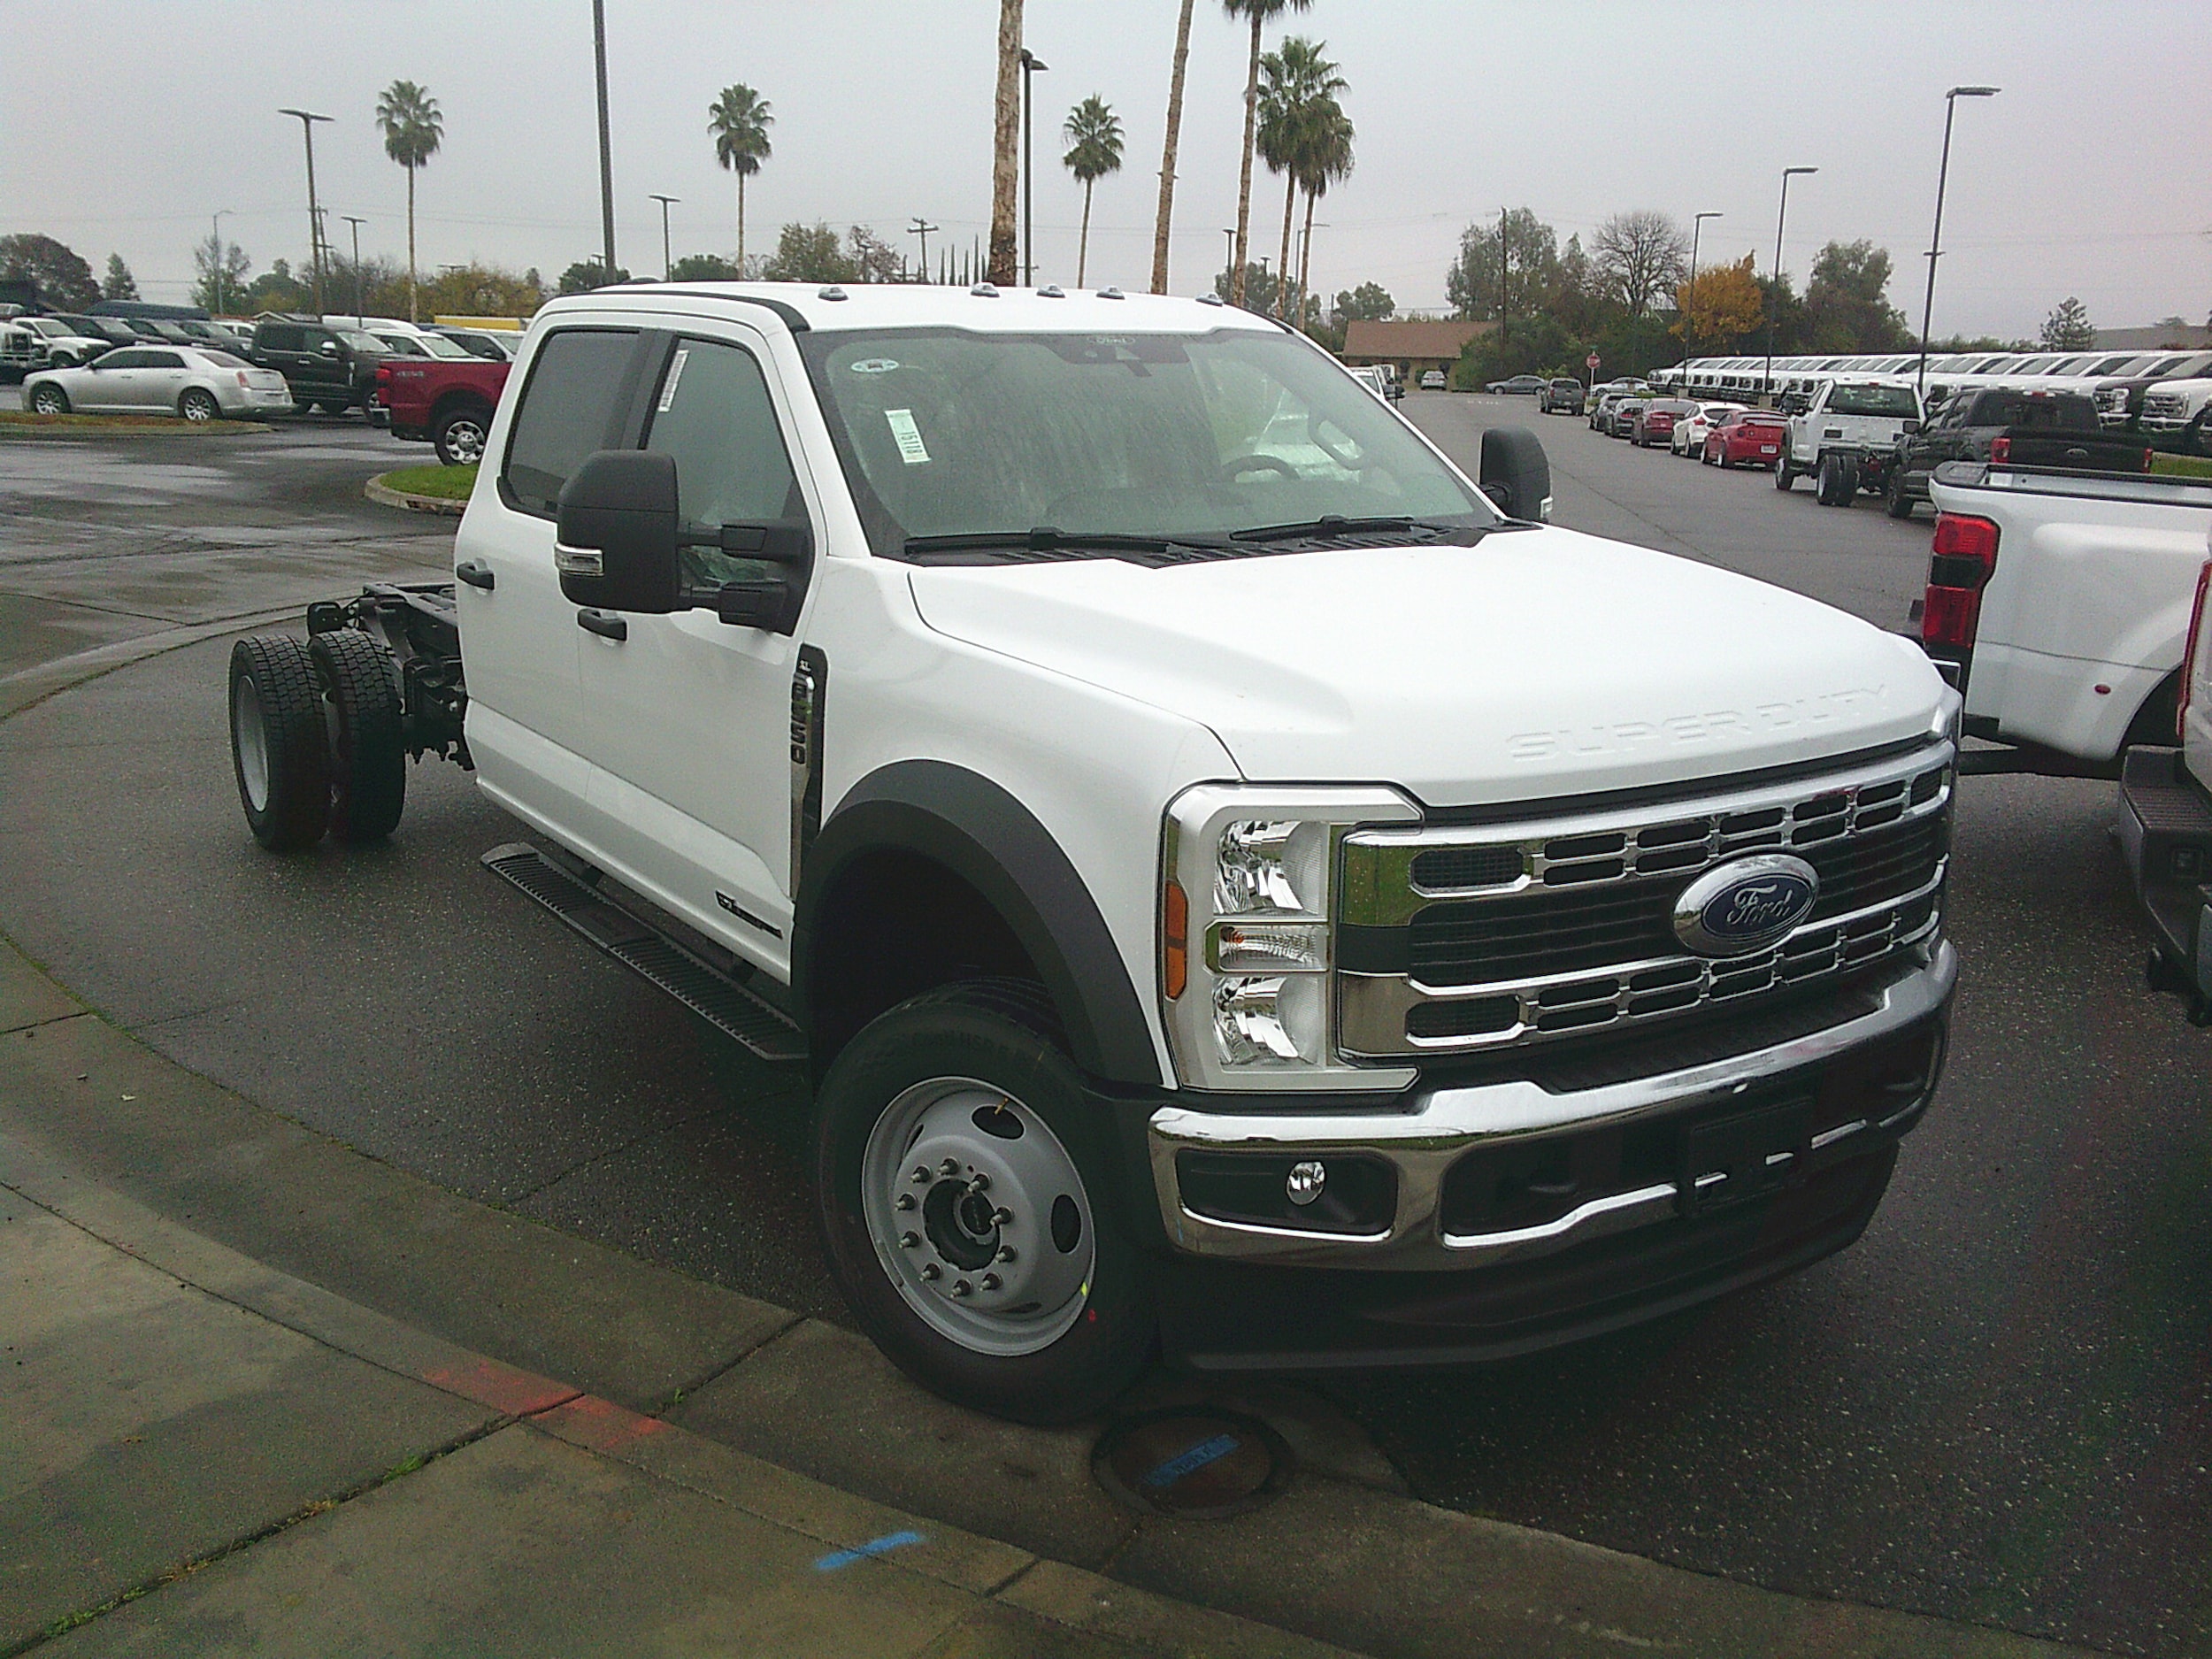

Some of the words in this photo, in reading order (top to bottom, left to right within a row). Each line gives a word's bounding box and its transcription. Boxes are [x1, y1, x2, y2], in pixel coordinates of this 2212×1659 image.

[1506, 710, 1753, 763] SUPER
[1755, 683, 1886, 731] DUTY
[1726, 884, 1793, 926] Ford
